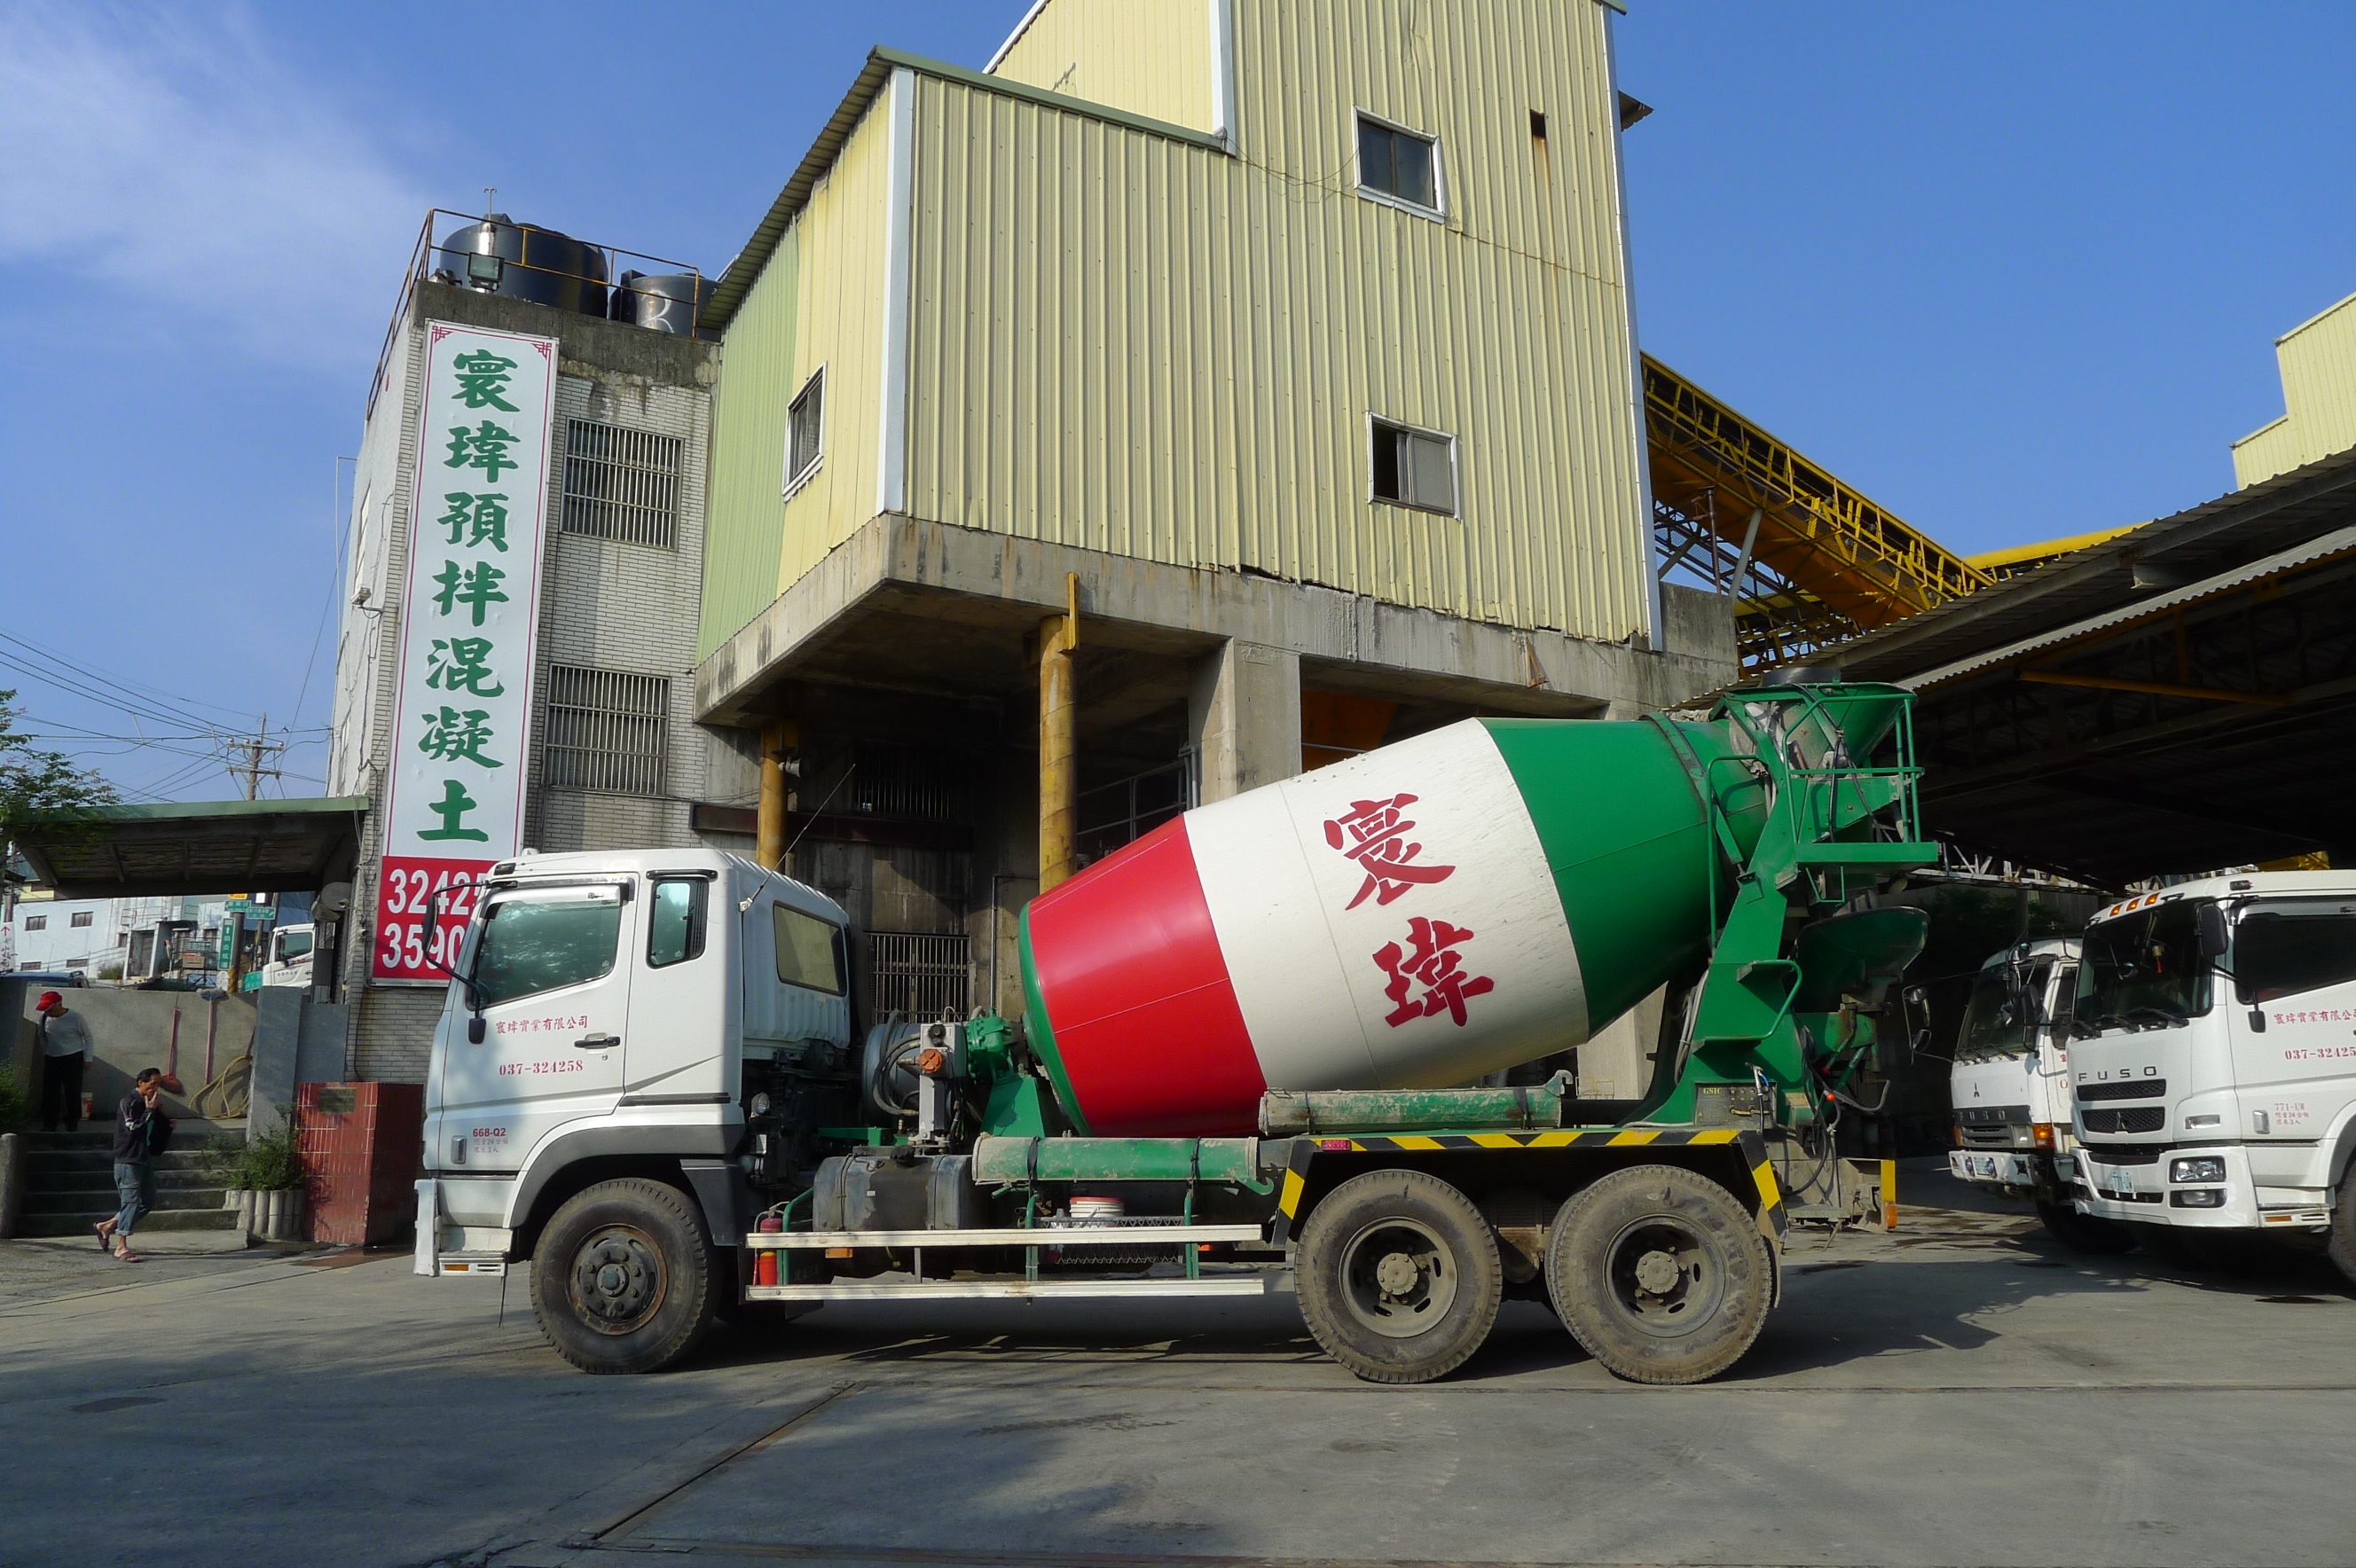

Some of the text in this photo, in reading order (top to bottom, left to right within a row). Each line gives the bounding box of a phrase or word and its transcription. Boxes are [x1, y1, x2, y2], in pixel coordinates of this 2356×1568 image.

[417, 349, 521, 842] 寰瑋預拌混凝土
[1323, 793, 1494, 1027] 寰瑋
[496, 1015, 588, 1034] 寰瑋實業有限公司
[499, 1060, 583, 1075] 037-324258
[2078, 1066, 2156, 1081] FUSO
[473, 1127, 507, 1137] 668-Q2
